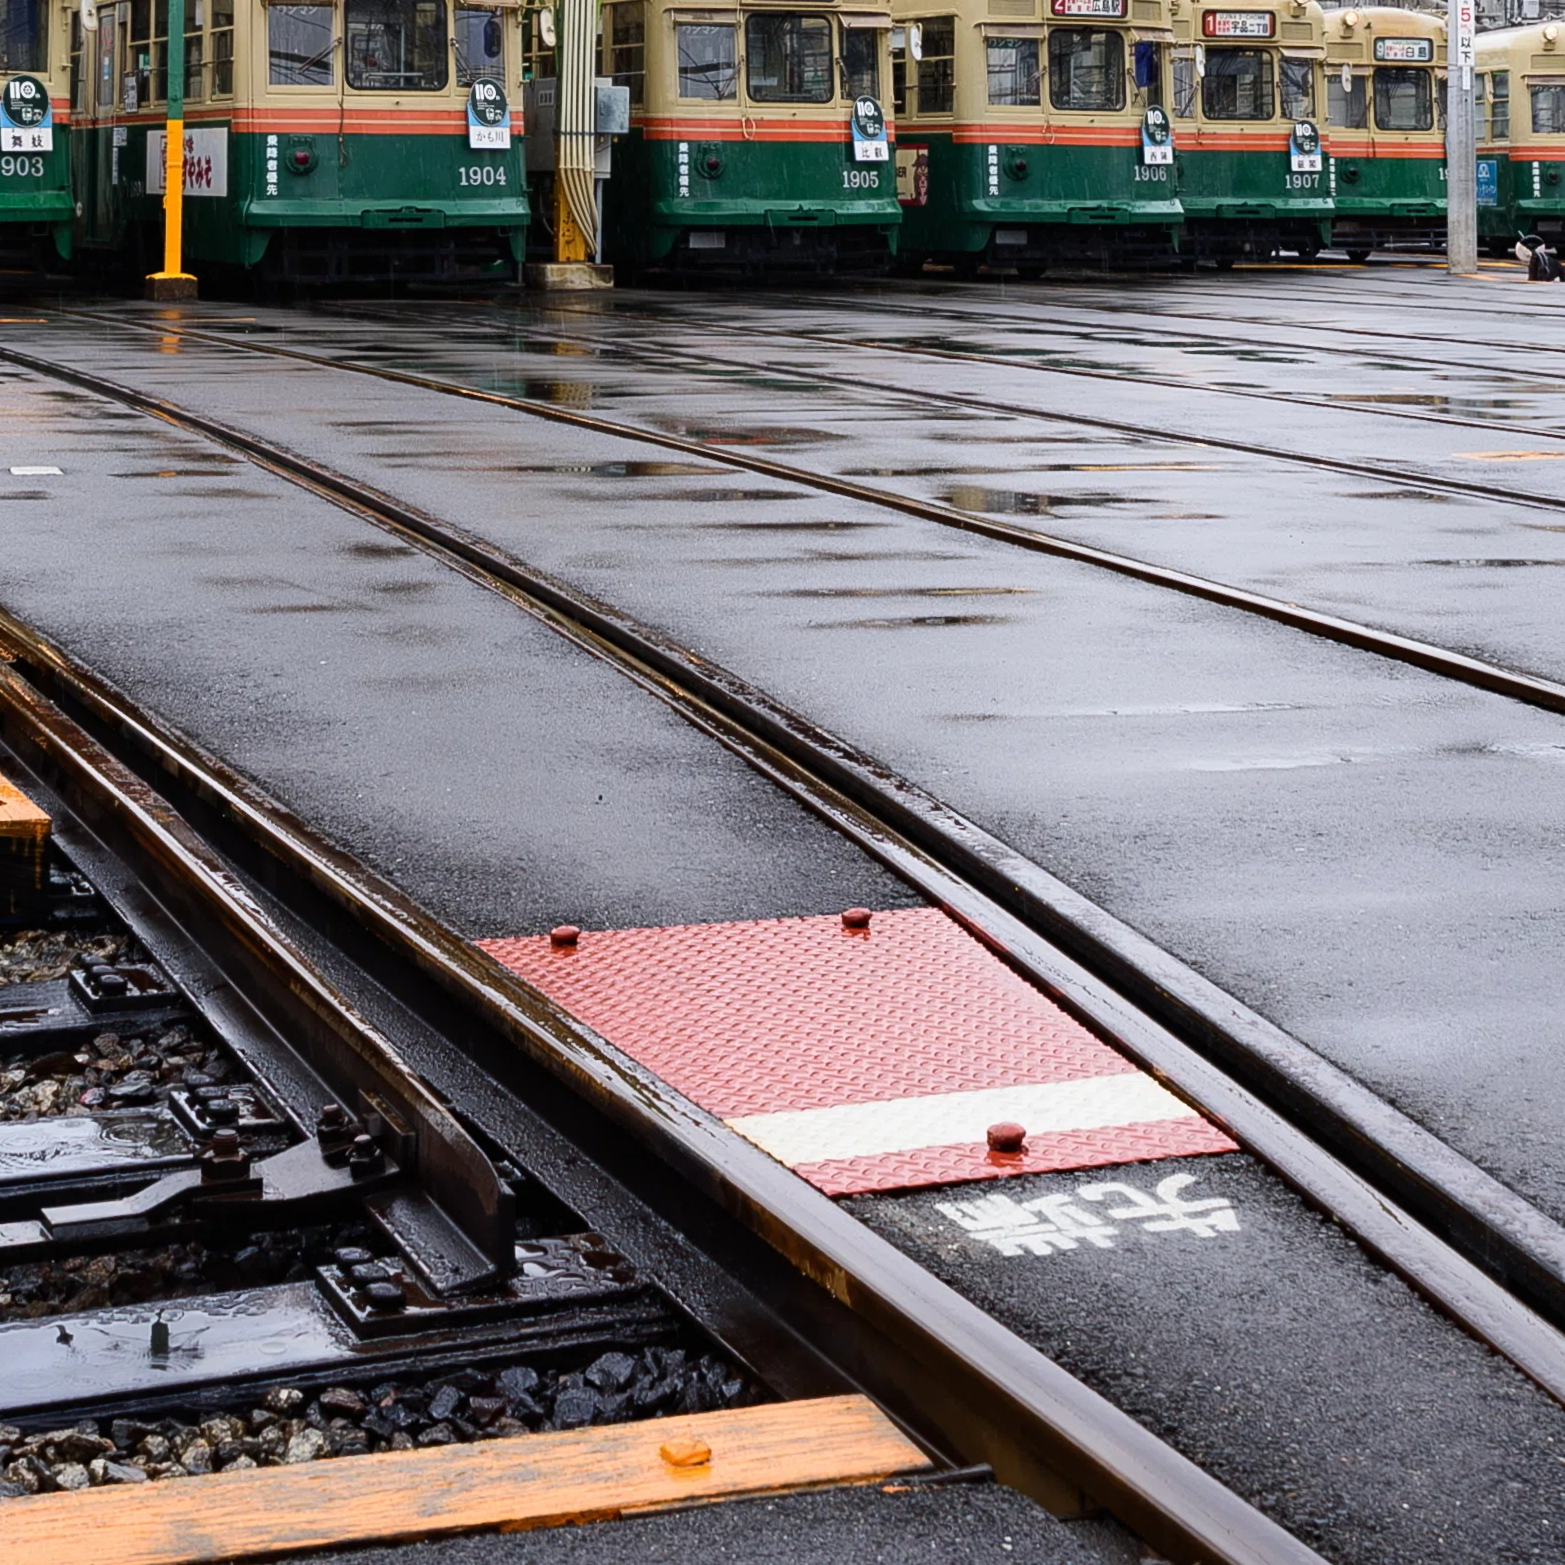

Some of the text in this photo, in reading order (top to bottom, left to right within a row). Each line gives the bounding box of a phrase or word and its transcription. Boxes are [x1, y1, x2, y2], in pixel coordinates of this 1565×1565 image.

[1461, 7, 1471, 23] 5
[1207, 16, 1214, 32] 1
[1461, 37, 1471, 64] 以下
[476, 130, 504, 143] かも川
[459, 166, 507, 186] 1904
[842, 170, 879, 188] 1905
[1134, 165, 1167, 181] 1906
[1285, 174, 1320, 189] 1907
[936, 1172, 1242, 1257] 先端
